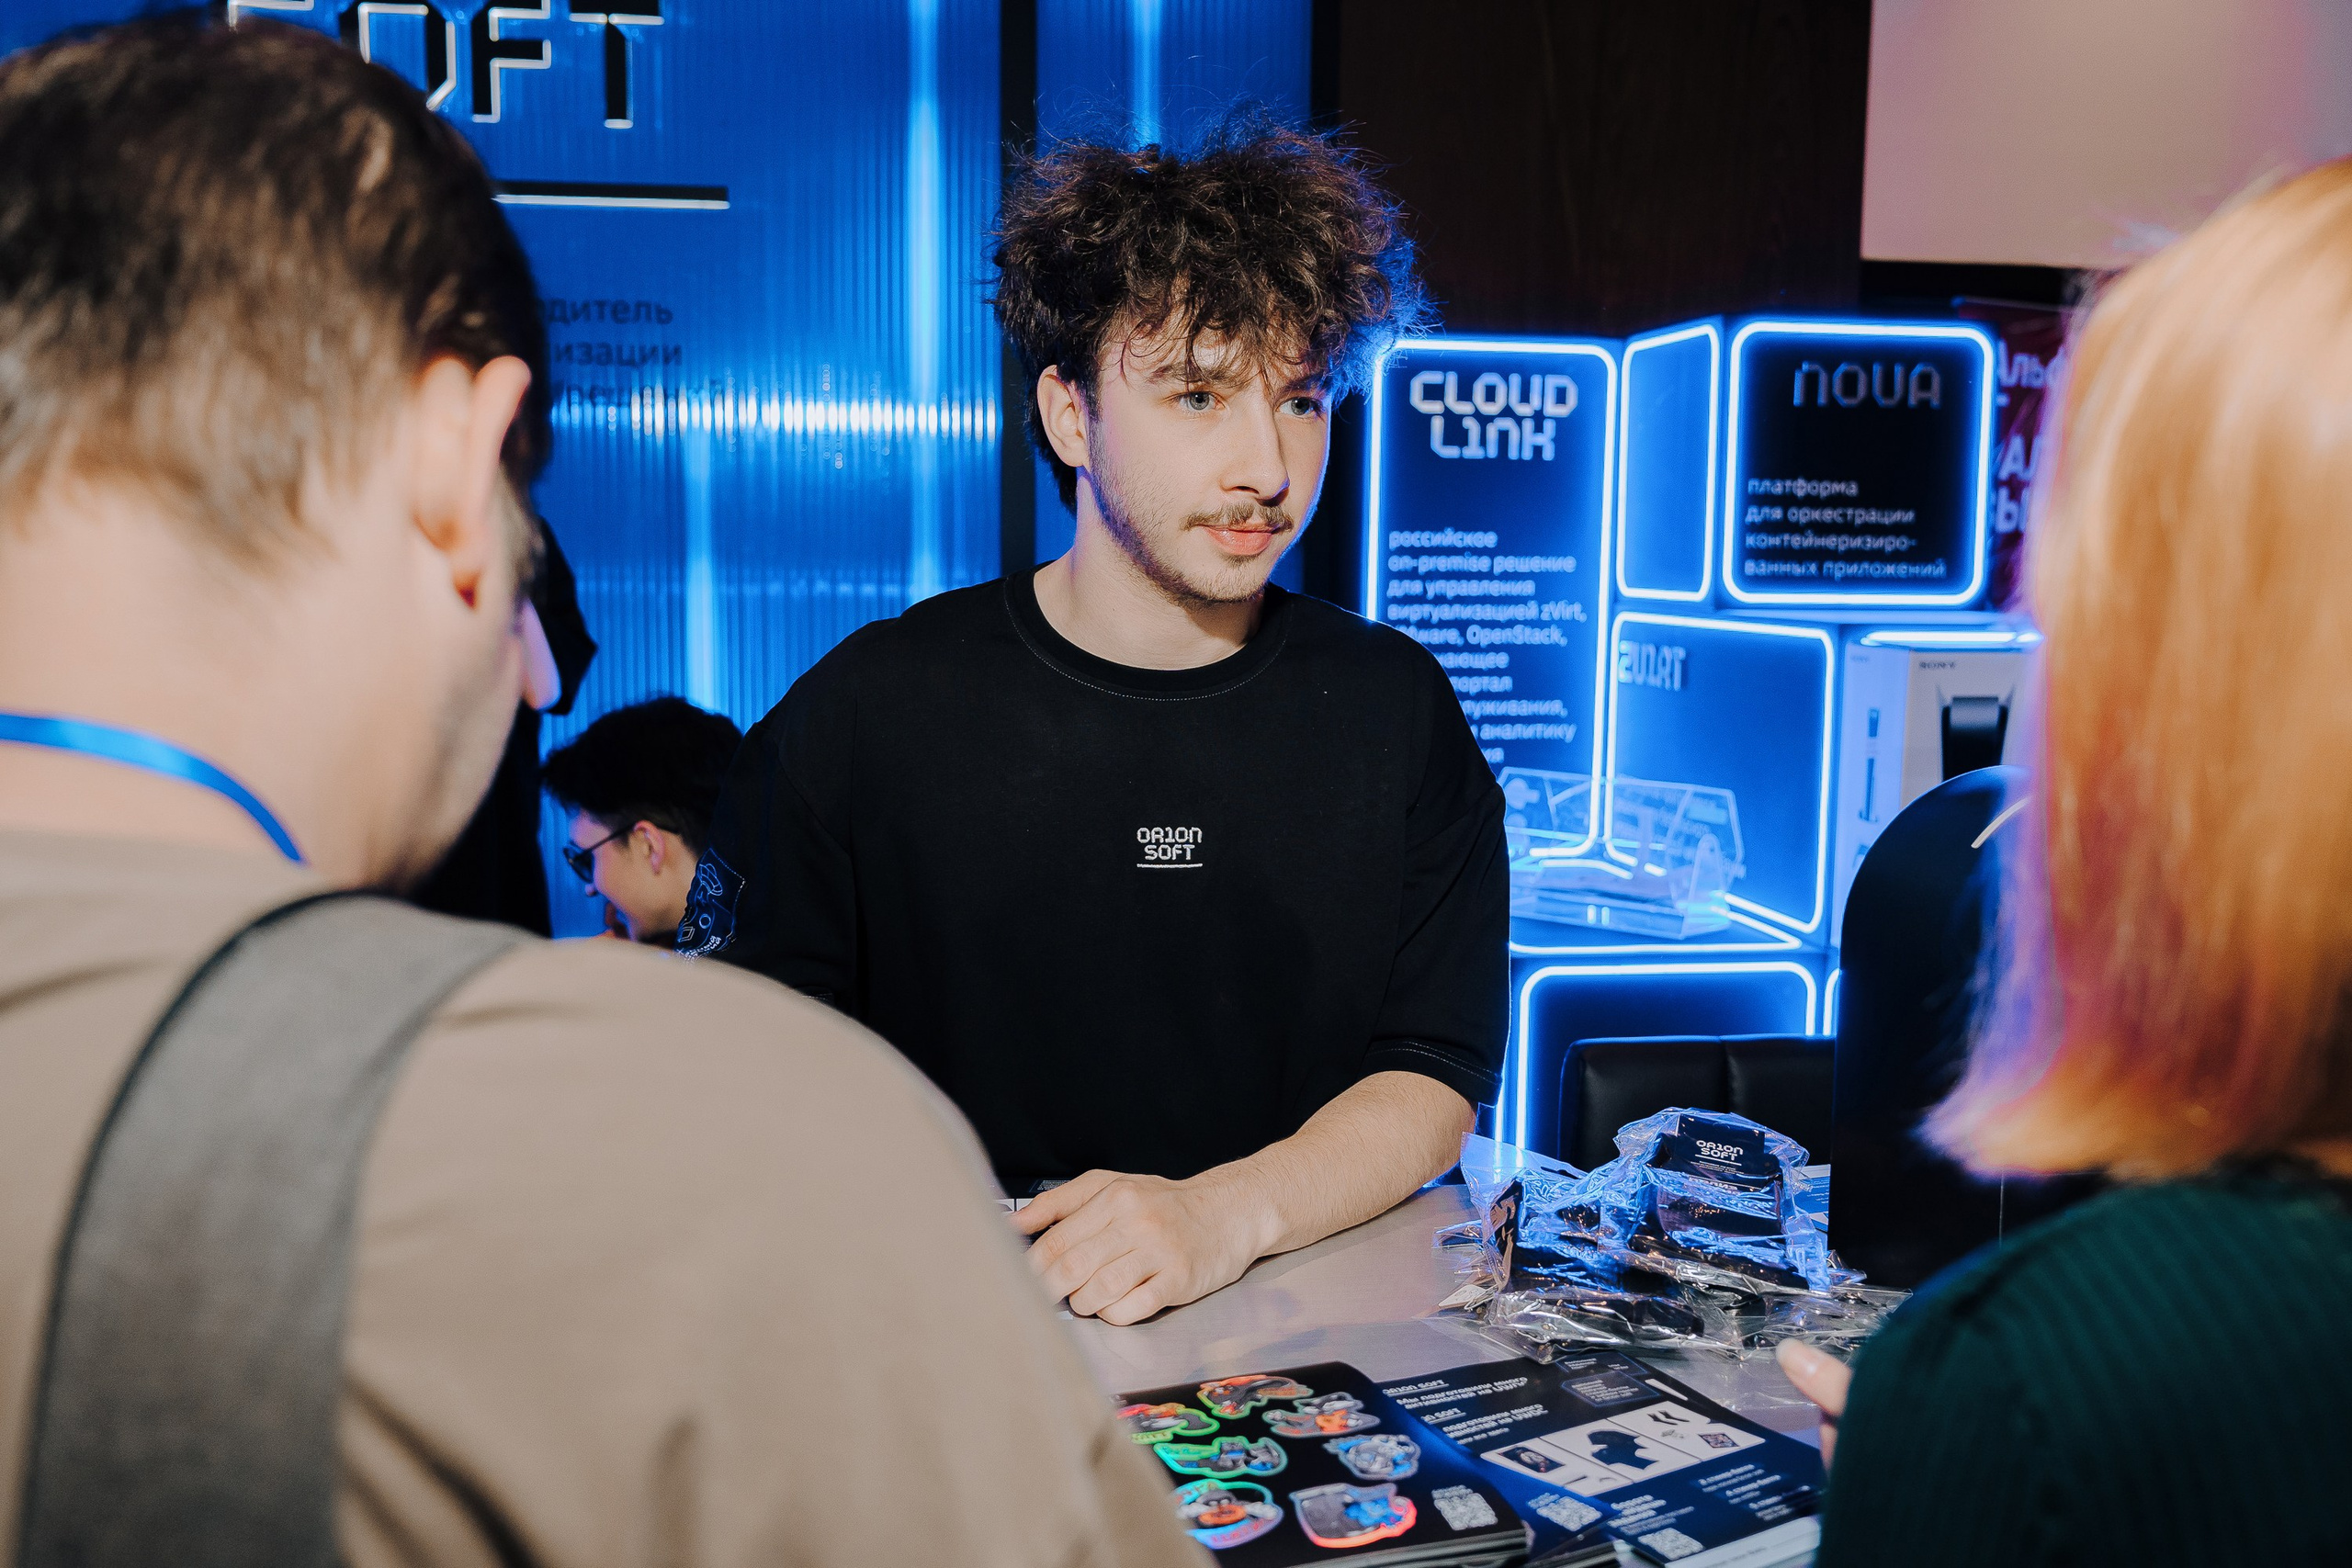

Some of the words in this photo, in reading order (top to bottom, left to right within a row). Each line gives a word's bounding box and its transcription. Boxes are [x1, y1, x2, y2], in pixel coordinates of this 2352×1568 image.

[228, 0, 664, 129] OFT
[1409, 370, 1579, 418] CLOUD
[1747, 476, 1859, 499] платформа
[1746, 506, 1783, 525] для
[1787, 506, 1916, 527] оркестрации
[1388, 526, 1498, 550] российское
[1746, 529, 1918, 554] контейнеризиро-
[1493, 555, 1577, 576] решение
[1745, 559, 1819, 577] ванных
[1822, 558, 1947, 581] приложений
[1386, 579, 1424, 598] для
[1425, 579, 1536, 600] управления
[1387, 600, 1539, 624] виртуализацией
[1466, 624, 1568, 648] OpenStack,
[1435, 651, 1510, 670] ающее
[1459, 699, 1569, 720] луживания,
[1480, 723, 1577, 743] аналитику
[1144, 844, 1195, 861] SOFT
[1701, 1147, 1737, 1161] SOFT
[1418, 1380, 1445, 1389] SOFT
